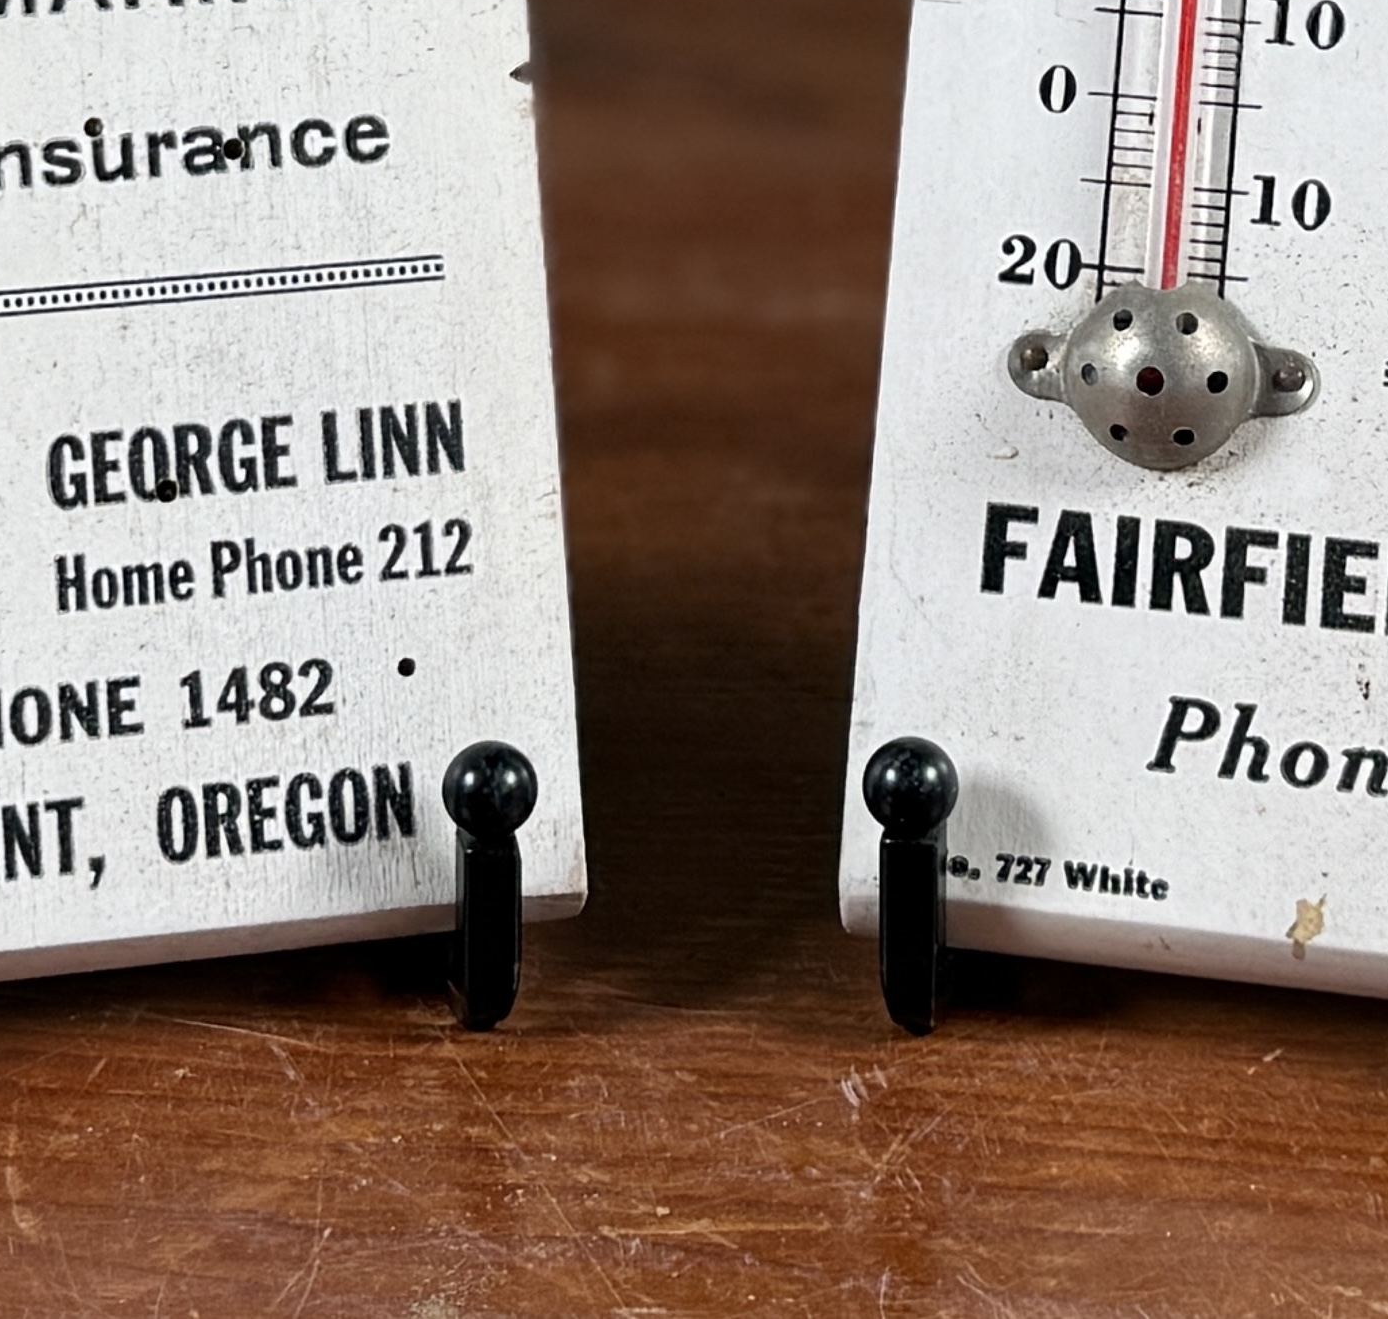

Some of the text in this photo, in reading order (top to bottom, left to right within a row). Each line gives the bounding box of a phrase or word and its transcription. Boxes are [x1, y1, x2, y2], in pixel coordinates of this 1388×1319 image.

[1038, 64, 1078, 115] 0
[1249, 173, 1333, 232] 10
[997, 233, 1085, 291] 20
[47, 398, 466, 512] GEORGE LINN
[53, 517, 473, 613] Home Phone 212
[178, 657, 336, 731] 1482
[155, 760, 418, 864] OREGON
[947, 851, 1170, 902] o. 727 White
